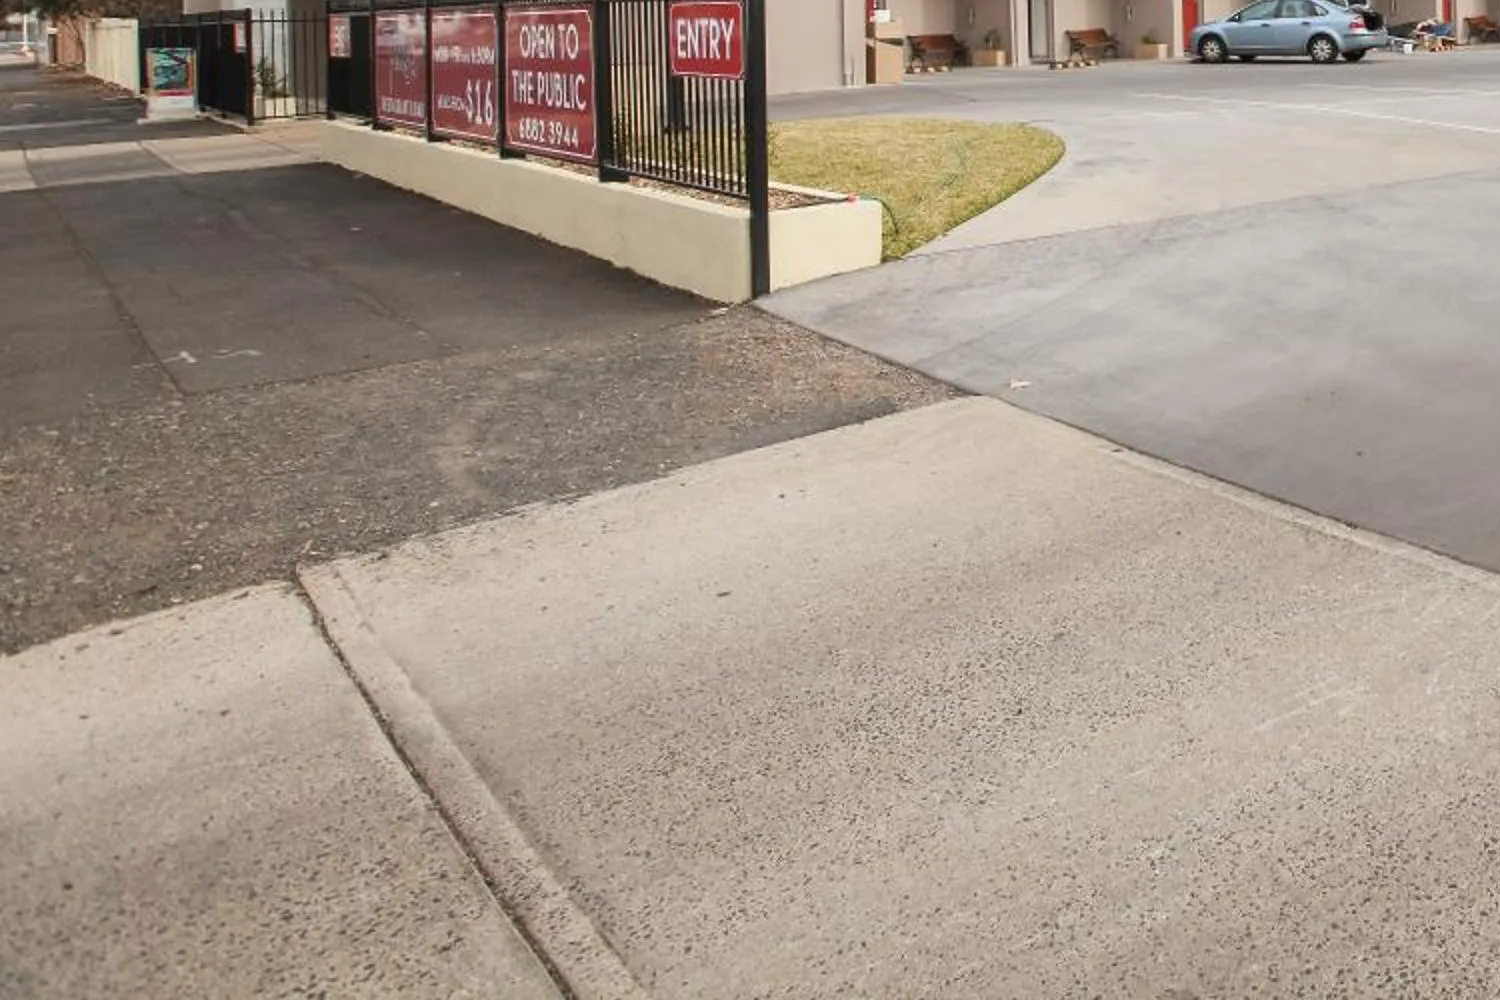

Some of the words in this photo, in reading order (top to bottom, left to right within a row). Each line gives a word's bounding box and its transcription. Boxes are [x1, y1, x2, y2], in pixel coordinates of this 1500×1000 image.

[519, 23, 555, 60] OPEN
[557, 23, 579, 60] TO
[677, 17, 735, 60] ENTRY
[511, 69, 534, 104] THE
[537, 71, 587, 111] PUBLIC
